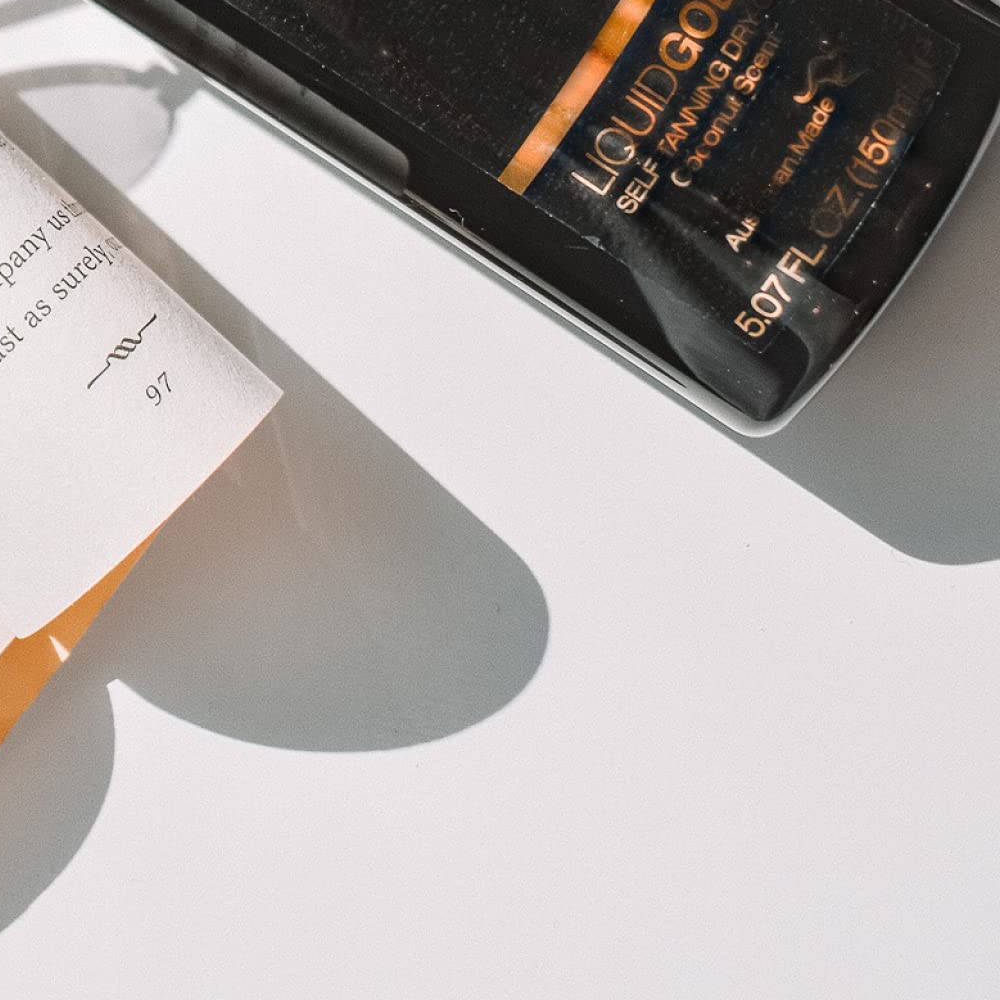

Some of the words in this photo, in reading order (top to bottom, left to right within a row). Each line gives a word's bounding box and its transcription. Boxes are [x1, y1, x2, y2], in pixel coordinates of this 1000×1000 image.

[616, 157, 660, 214] SELF
[657, 60, 732, 156] TANNING
[671, 94, 744, 188] Coconut
[733, 33, 783, 95] Scent
[787, 96, 836, 156] Made
[24, 299, 52, 329] as
[734, 272, 792, 338] 5.07
[145, 371, 173, 407] 97
